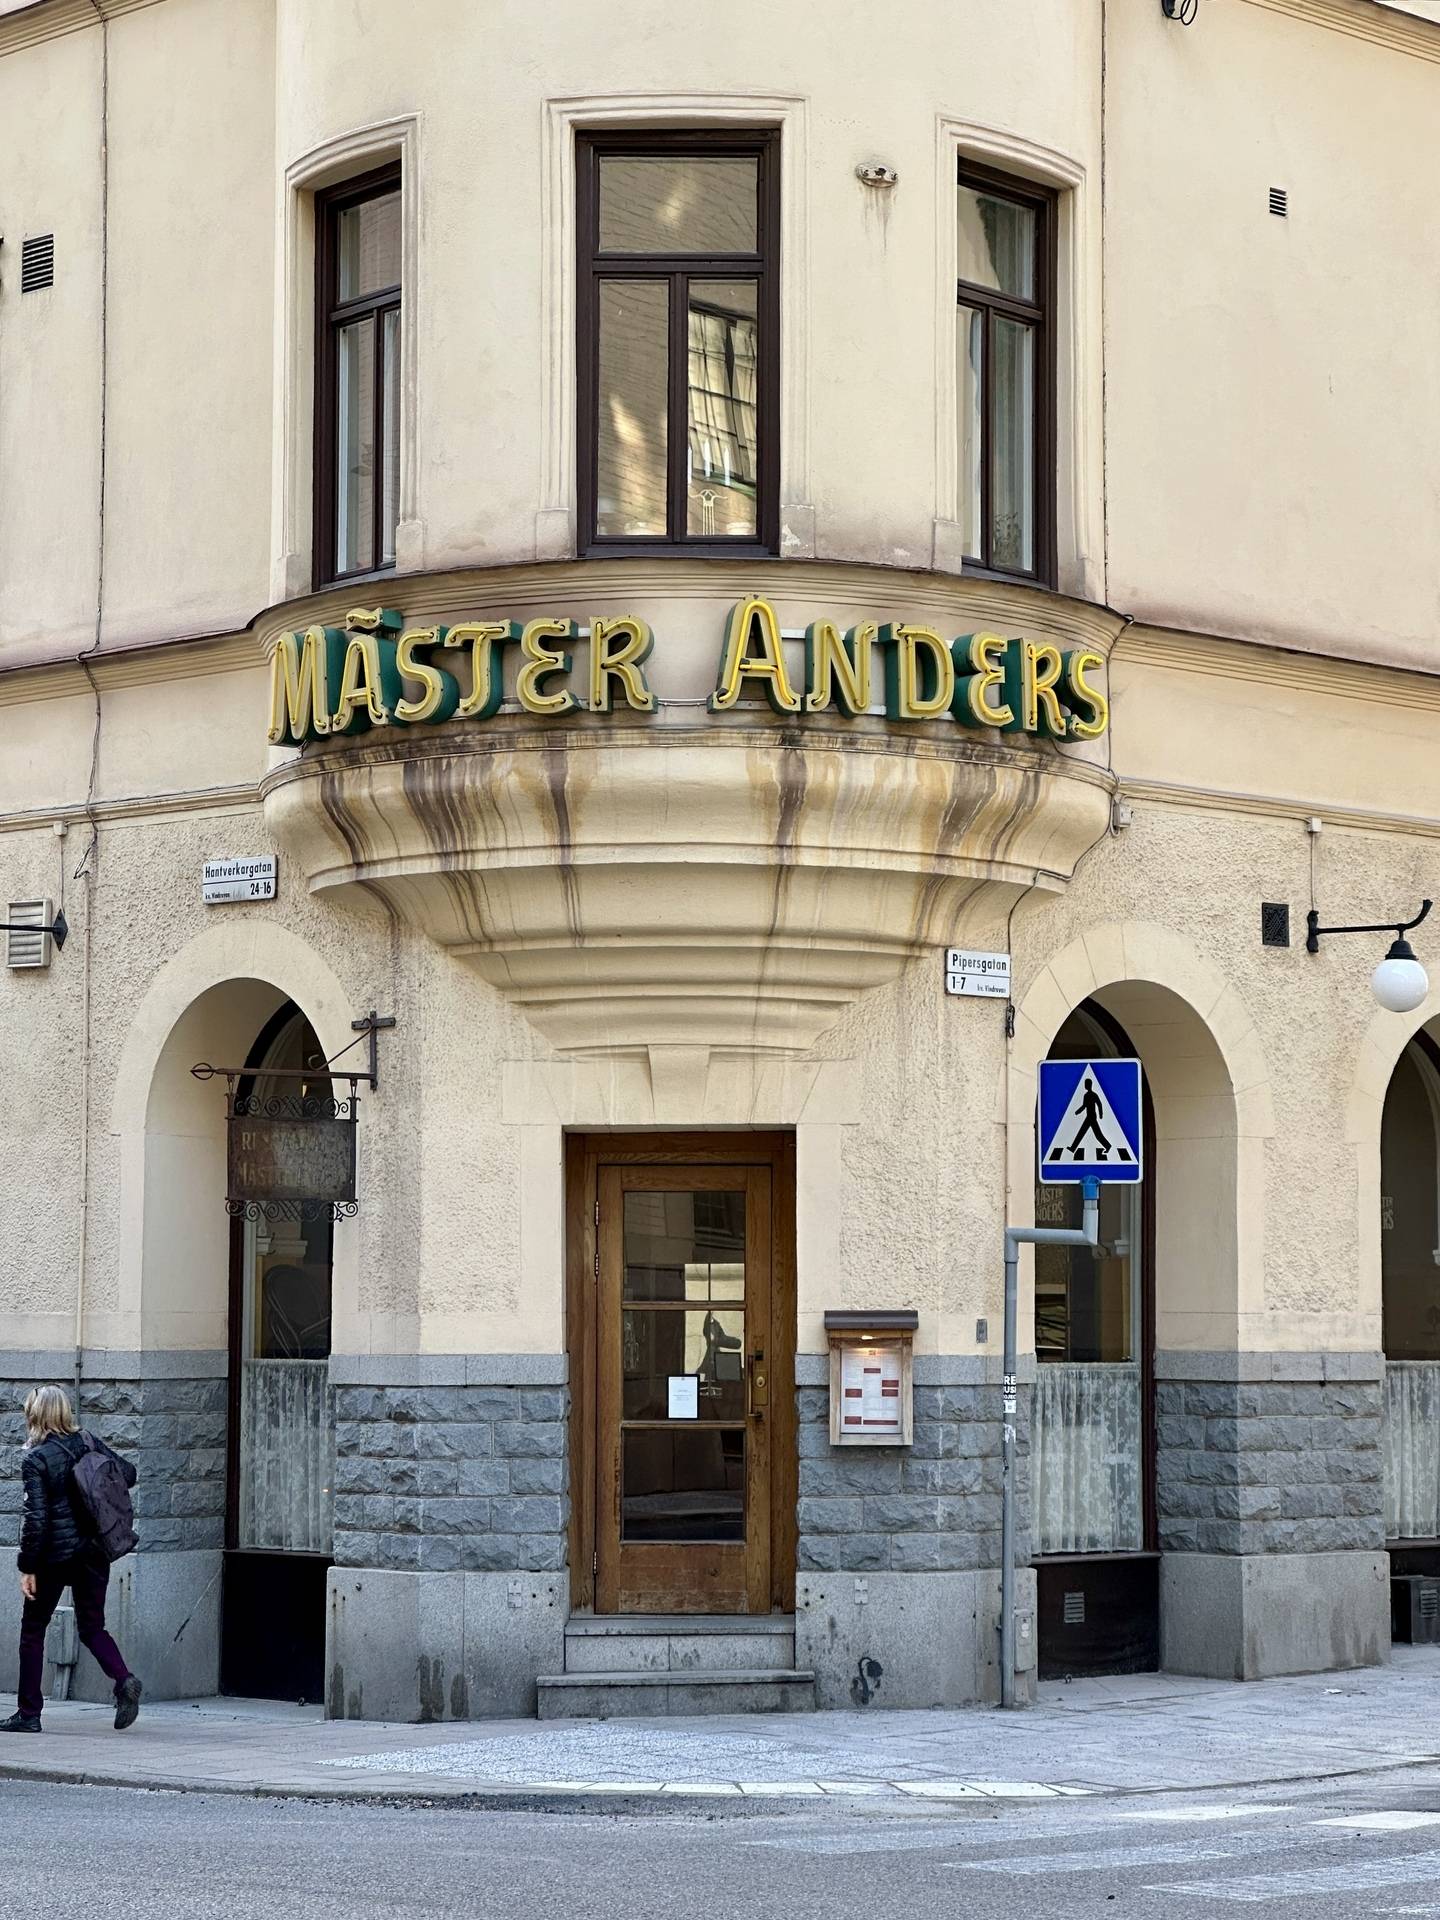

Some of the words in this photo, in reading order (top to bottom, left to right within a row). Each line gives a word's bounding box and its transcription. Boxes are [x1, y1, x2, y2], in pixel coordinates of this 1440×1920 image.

[707, 593, 1109, 743] ANDERS
[205, 862, 272, 878] Hantverkargatan
[250, 881, 272, 895] 24-16
[952, 953, 1007, 973] Pipersgatan
[952, 976, 966, 990] 1-7
